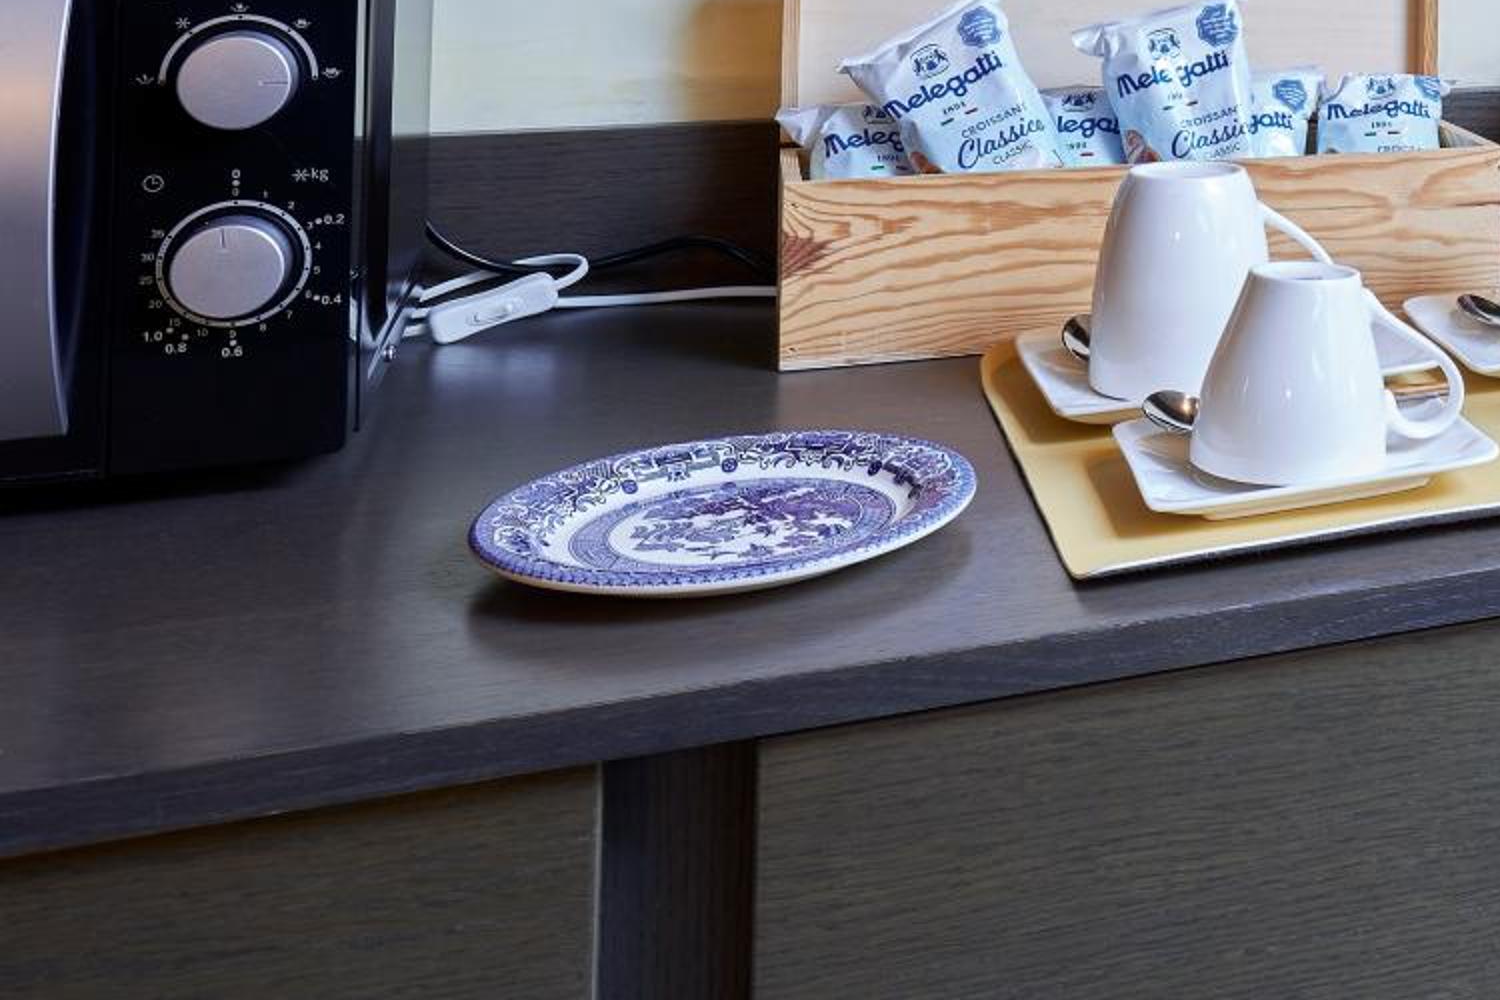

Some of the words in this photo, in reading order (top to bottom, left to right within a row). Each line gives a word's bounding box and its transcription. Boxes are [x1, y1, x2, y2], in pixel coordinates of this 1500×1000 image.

[883, 50, 1003, 118] Melegatti
[957, 117, 1045, 169] Classico
[311, 168, 329, 182] kg
[323, 213, 345, 225] 0.2
[321, 295, 342, 305] 0.4
[143, 331, 163, 342] 1.0
[165, 343, 187, 354] 0.8
[221, 347, 243, 358] 0.6
